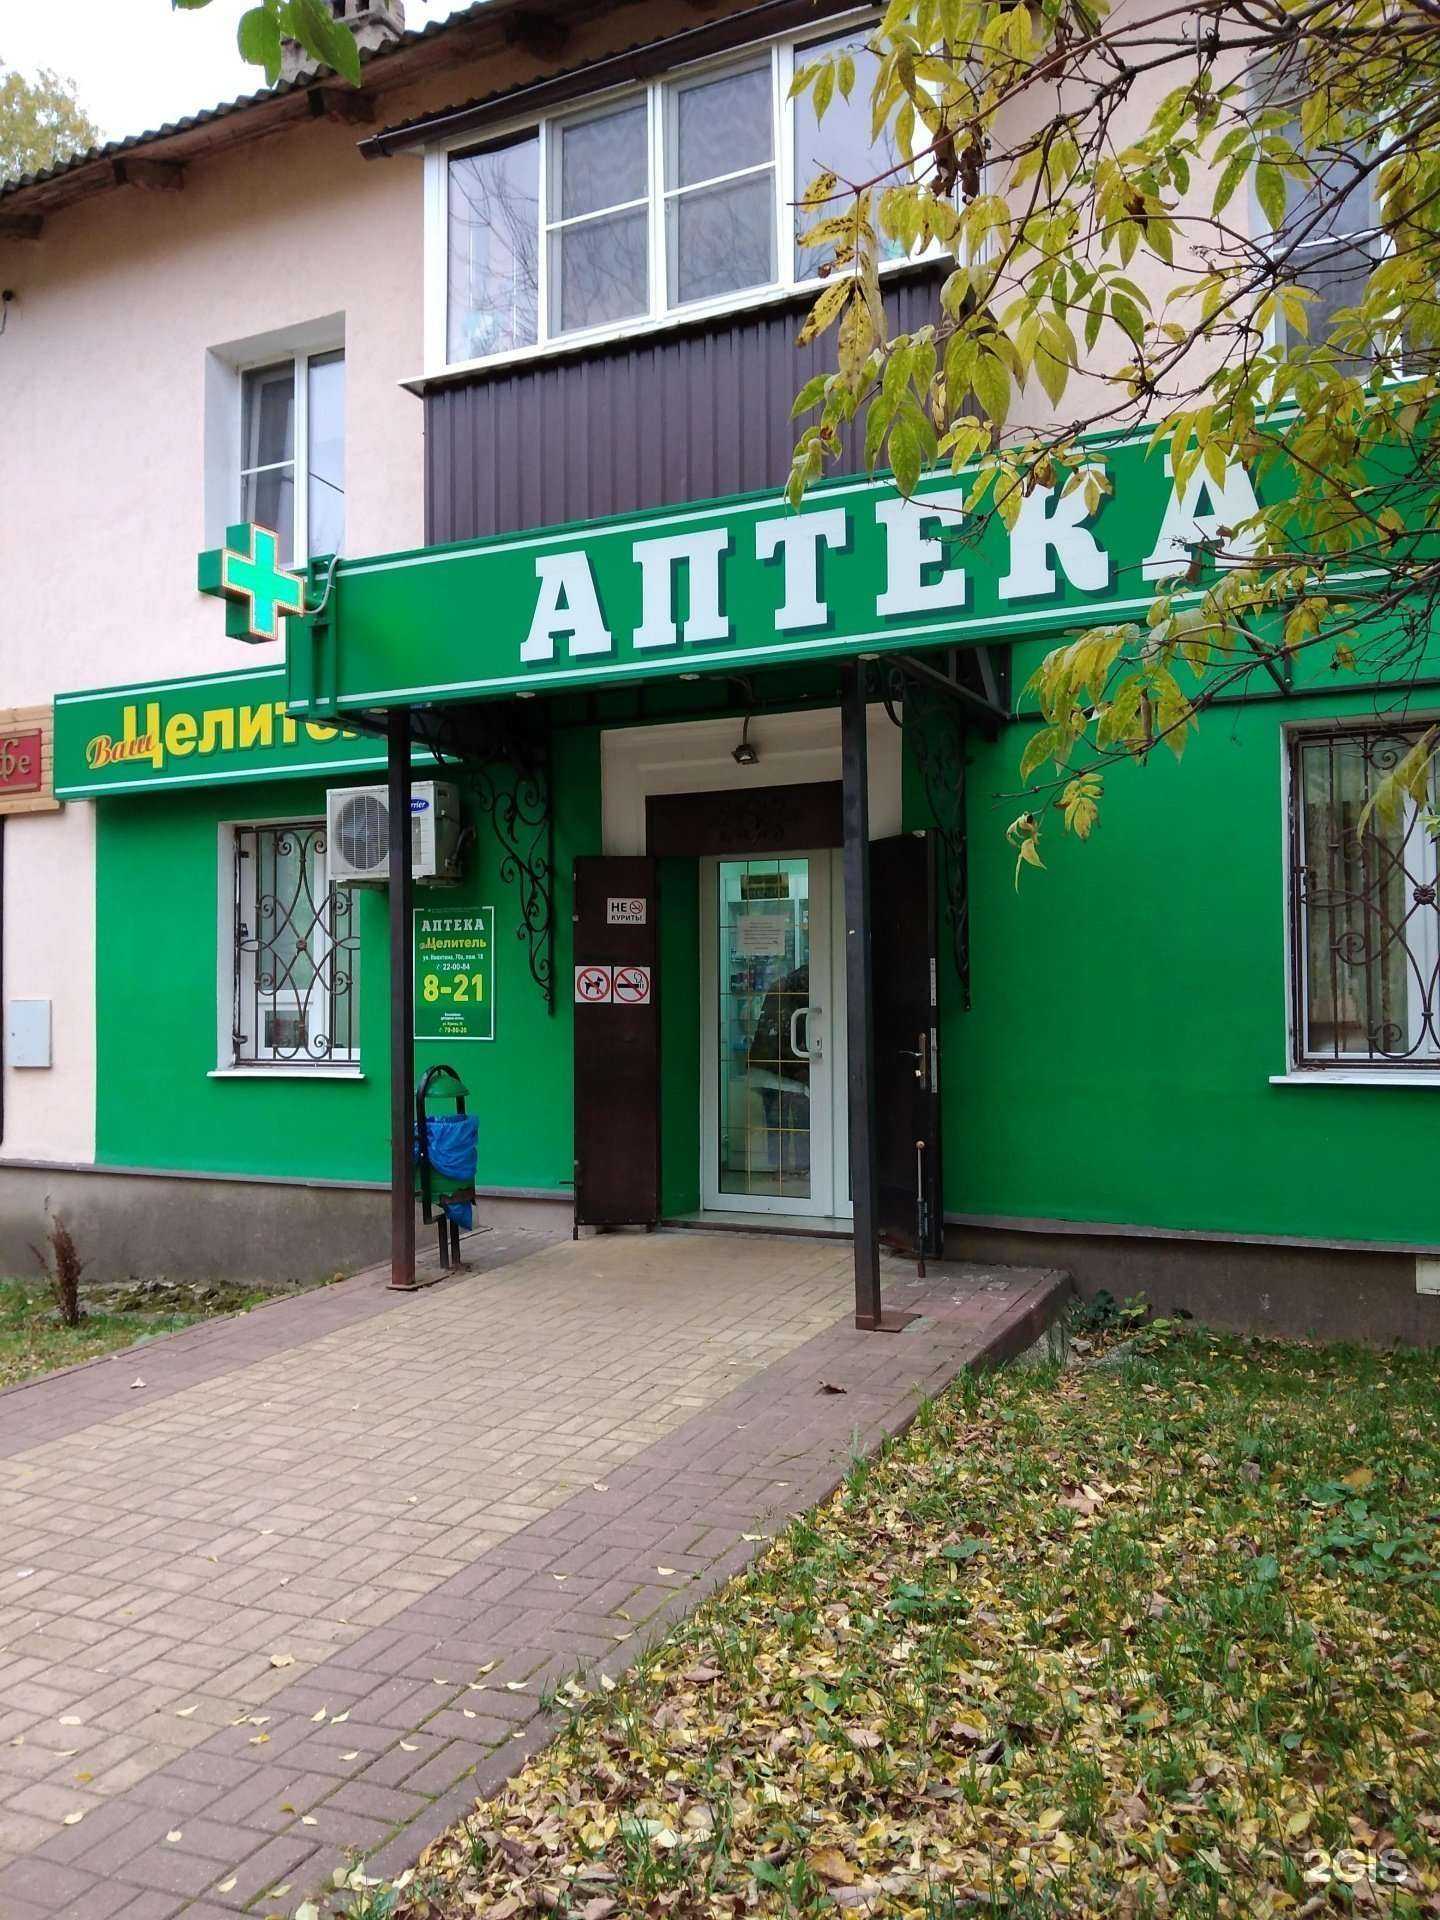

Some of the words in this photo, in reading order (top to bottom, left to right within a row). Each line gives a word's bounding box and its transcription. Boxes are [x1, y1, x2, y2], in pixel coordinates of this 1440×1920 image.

[520, 444, 1272, 662] АПТЕКА
[86, 735, 155, 769] Ваш
[124, 703, 358, 768] Целит
[611, 902, 627, 912] НЕ
[422, 919, 485, 932] АПТЕКА
[426, 937, 487, 950] Целитель
[424, 974, 483, 1001] 8-21
